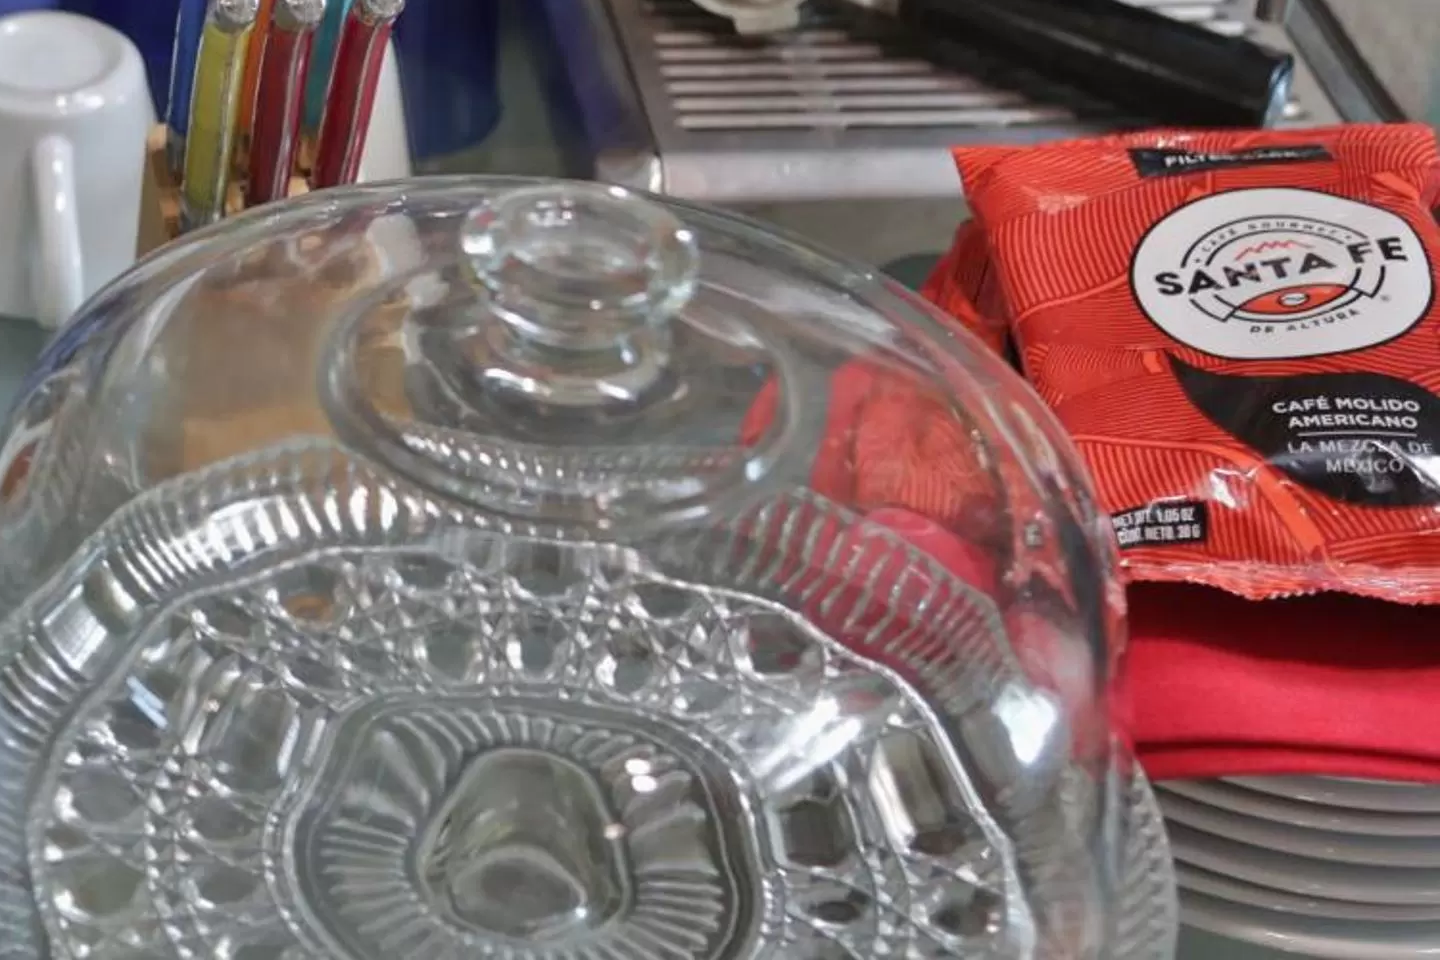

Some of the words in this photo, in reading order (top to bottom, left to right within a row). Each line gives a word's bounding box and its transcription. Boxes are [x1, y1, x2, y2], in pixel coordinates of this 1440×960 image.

[1154, 252, 1337, 297] SANTA
[1346, 236, 1408, 265] FE
[1249, 325, 1275, 334] DE
[1285, 307, 1361, 333] ALTURA
[1271, 395, 1331, 414] CAFÉ
[1335, 397, 1421, 413] MOLIDO
[1288, 413, 1419, 430] AMERICANO
[1287, 441, 1312, 455] LA
[1408, 442, 1433, 455] DE
